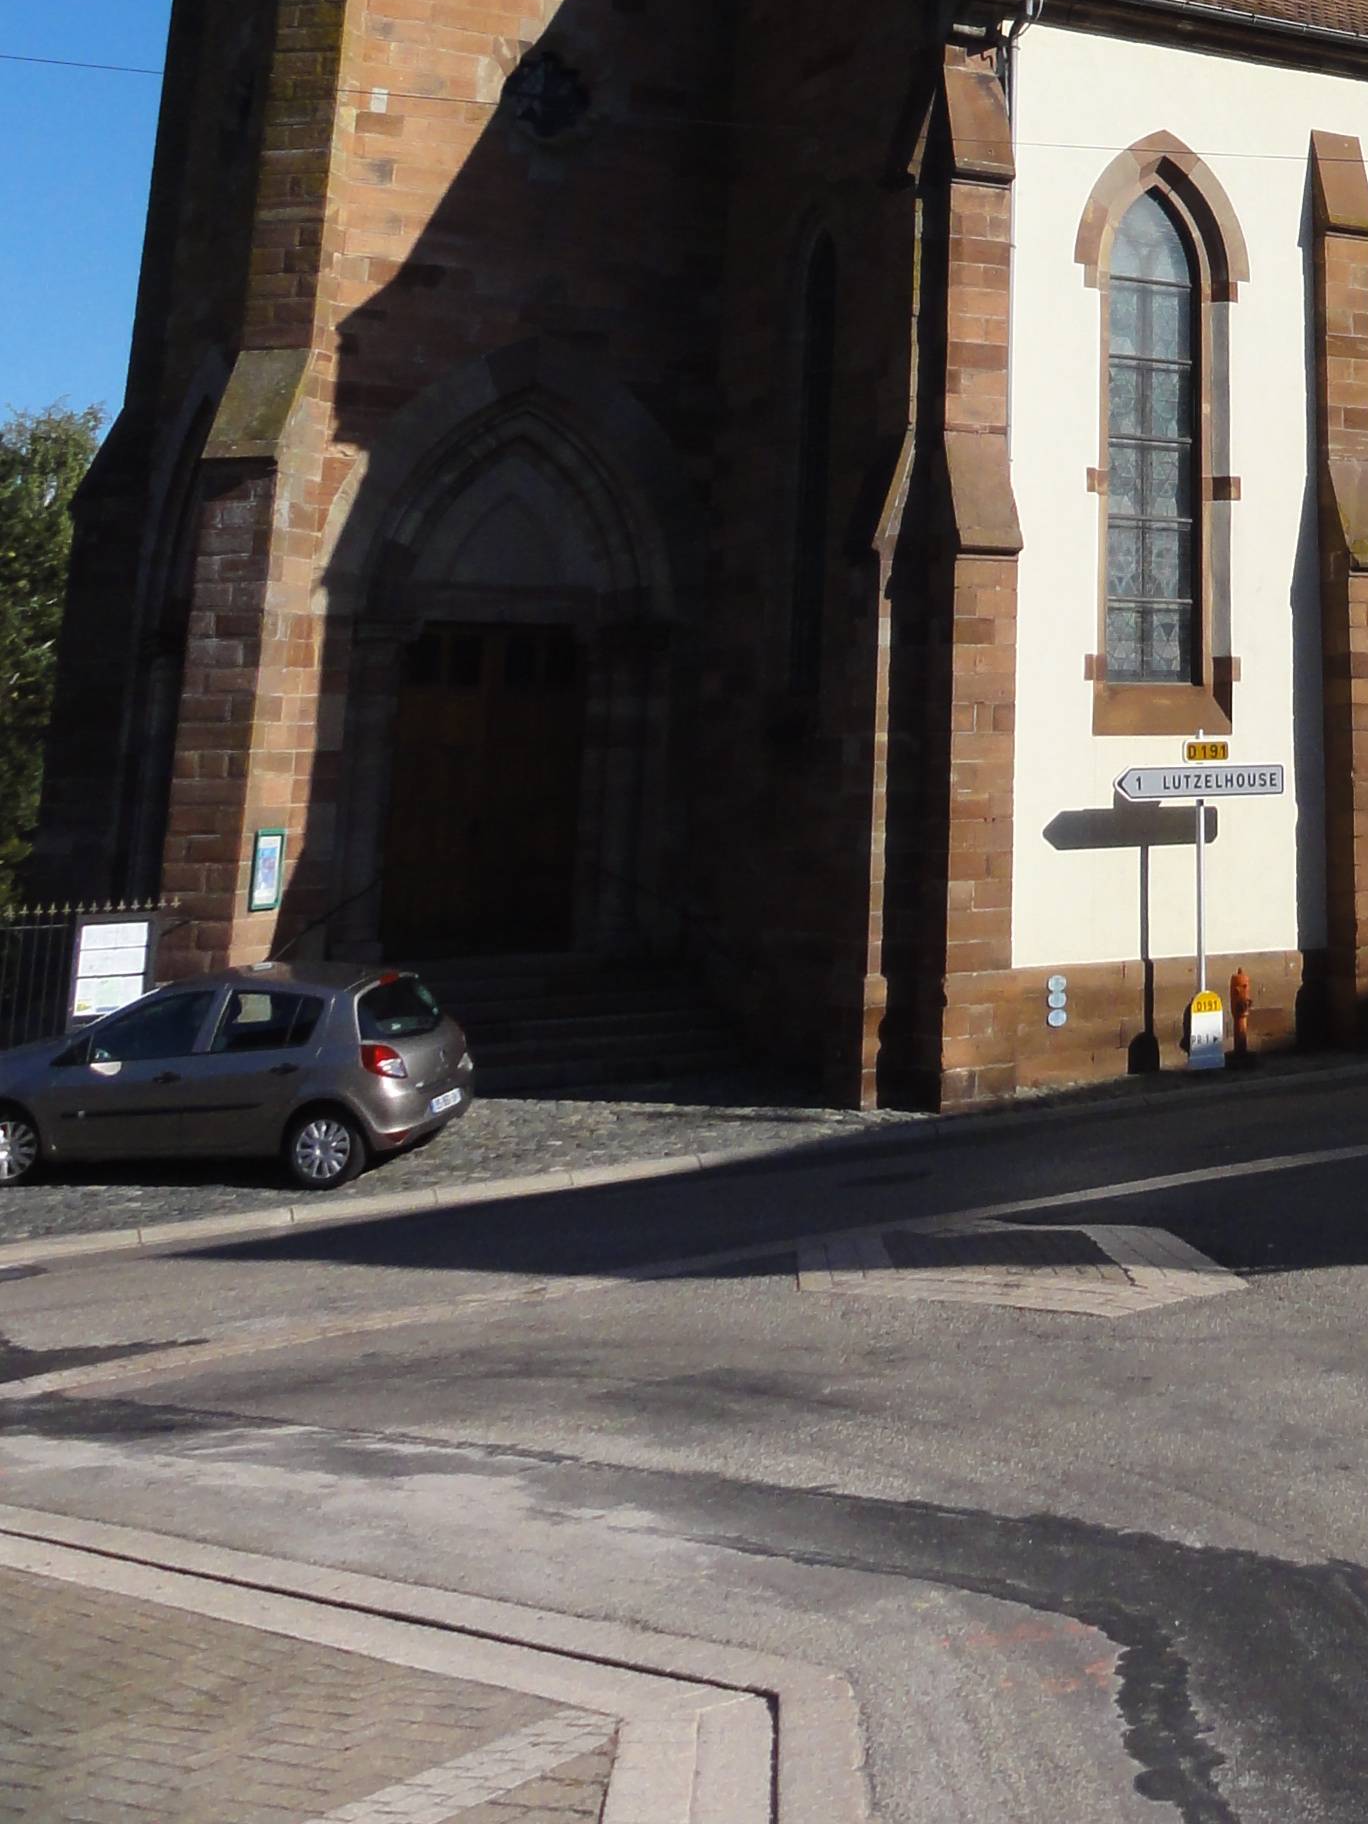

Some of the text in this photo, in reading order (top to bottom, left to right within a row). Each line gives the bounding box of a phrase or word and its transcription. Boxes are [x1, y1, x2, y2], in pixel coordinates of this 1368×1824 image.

[1187, 744, 1227, 760] D 191
[1135, 772, 1278, 791] 1 LUTZELHOUSE
